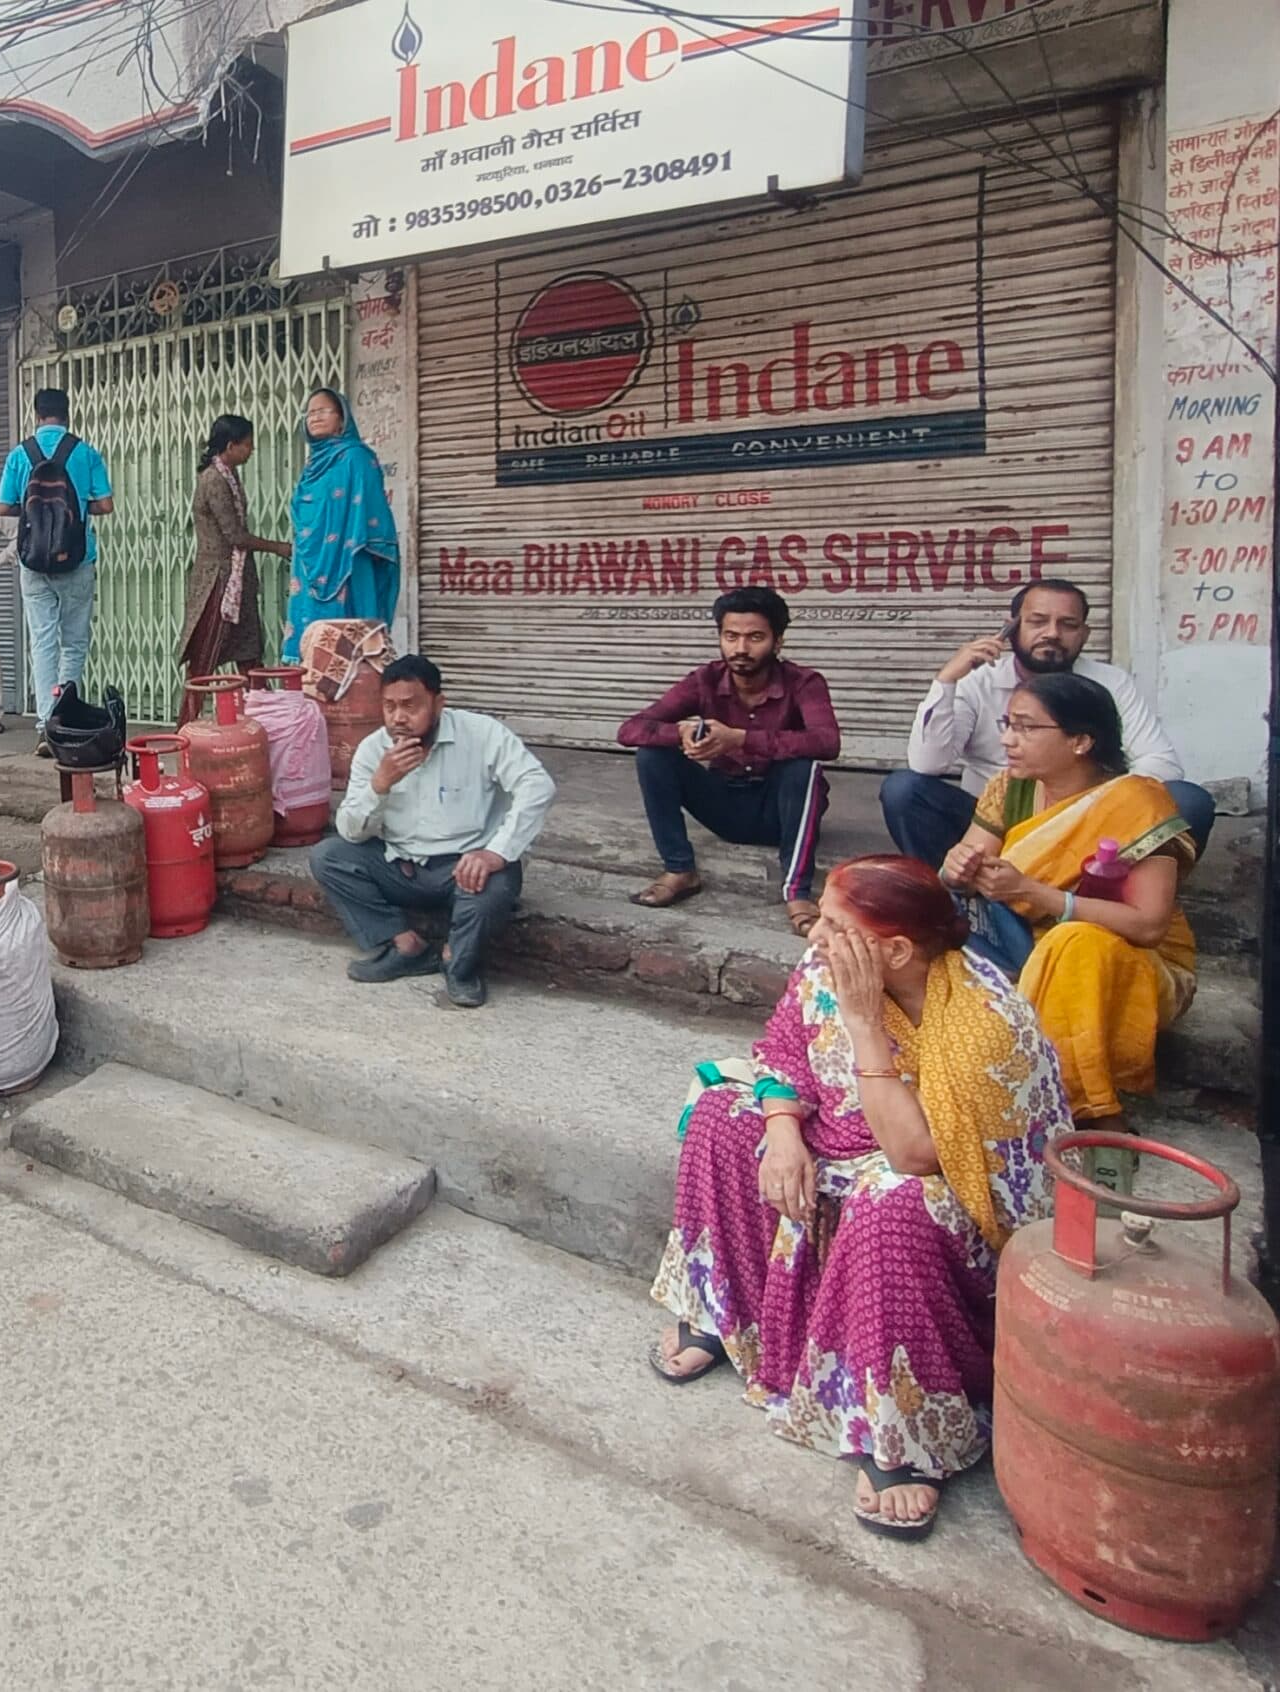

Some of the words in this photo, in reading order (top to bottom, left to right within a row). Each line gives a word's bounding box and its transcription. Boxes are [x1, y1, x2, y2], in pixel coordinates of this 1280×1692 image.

[394, 24, 680, 142] Indane
[420, 148, 446, 174] माँ
[449, 136, 515, 166] भवानी
[521, 126, 564, 150] गैस
[570, 109, 641, 141] सर्विस
[675, 321, 964, 424] Indane
[1169, 394, 1261, 424] MORNING
[1176, 436, 1195, 466] 9
[1203, 432, 1252, 461] AM
[715, 491, 772, 508] CLOSE
[1222, 495, 1266, 524] PM
[438, 545, 514, 597] Maa
[522, 537, 701, 596] BHAWANI
[714, 530, 809, 596] GAS
[822, 524, 1071, 594] SERVICE
[1230, 544, 1269, 573] PM
[1208, 613, 1259, 641] PM
